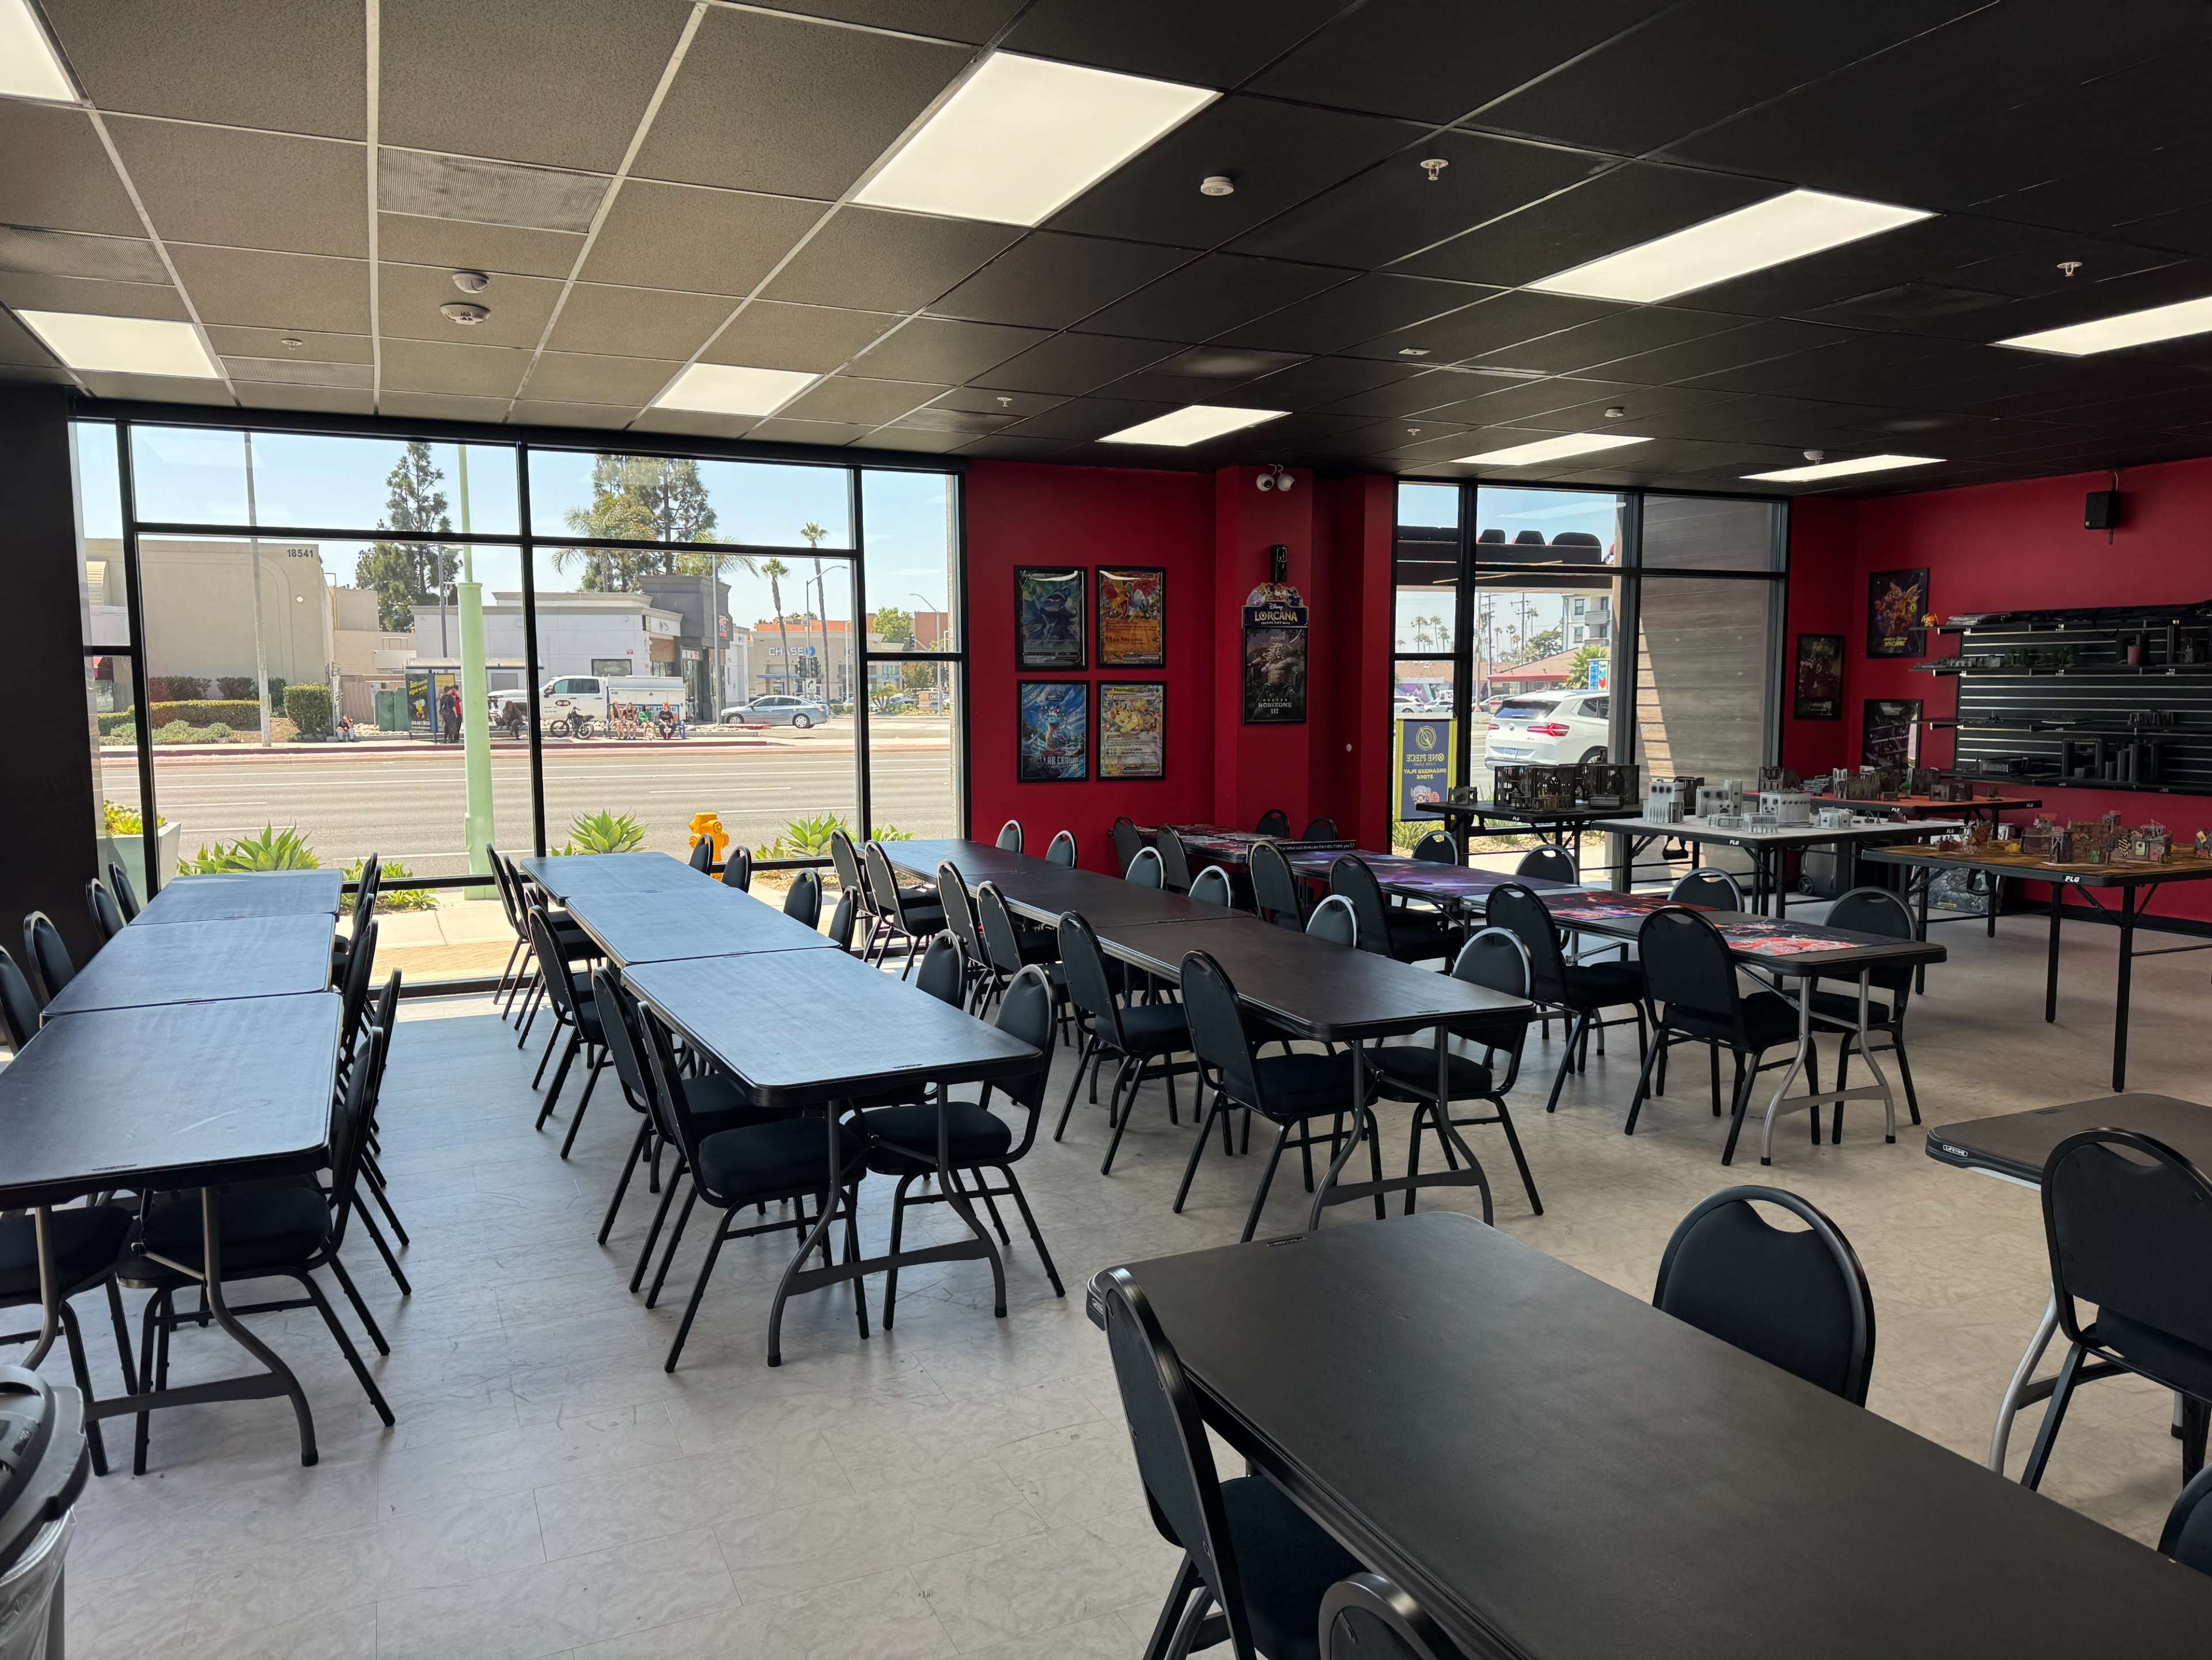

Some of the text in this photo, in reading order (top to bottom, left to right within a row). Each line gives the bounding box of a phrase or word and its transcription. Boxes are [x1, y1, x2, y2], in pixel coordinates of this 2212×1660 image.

[287, 549, 314, 558] 18541
[1254, 611, 1298, 622] LORCANA
[768, 647, 804, 656] CHASE
